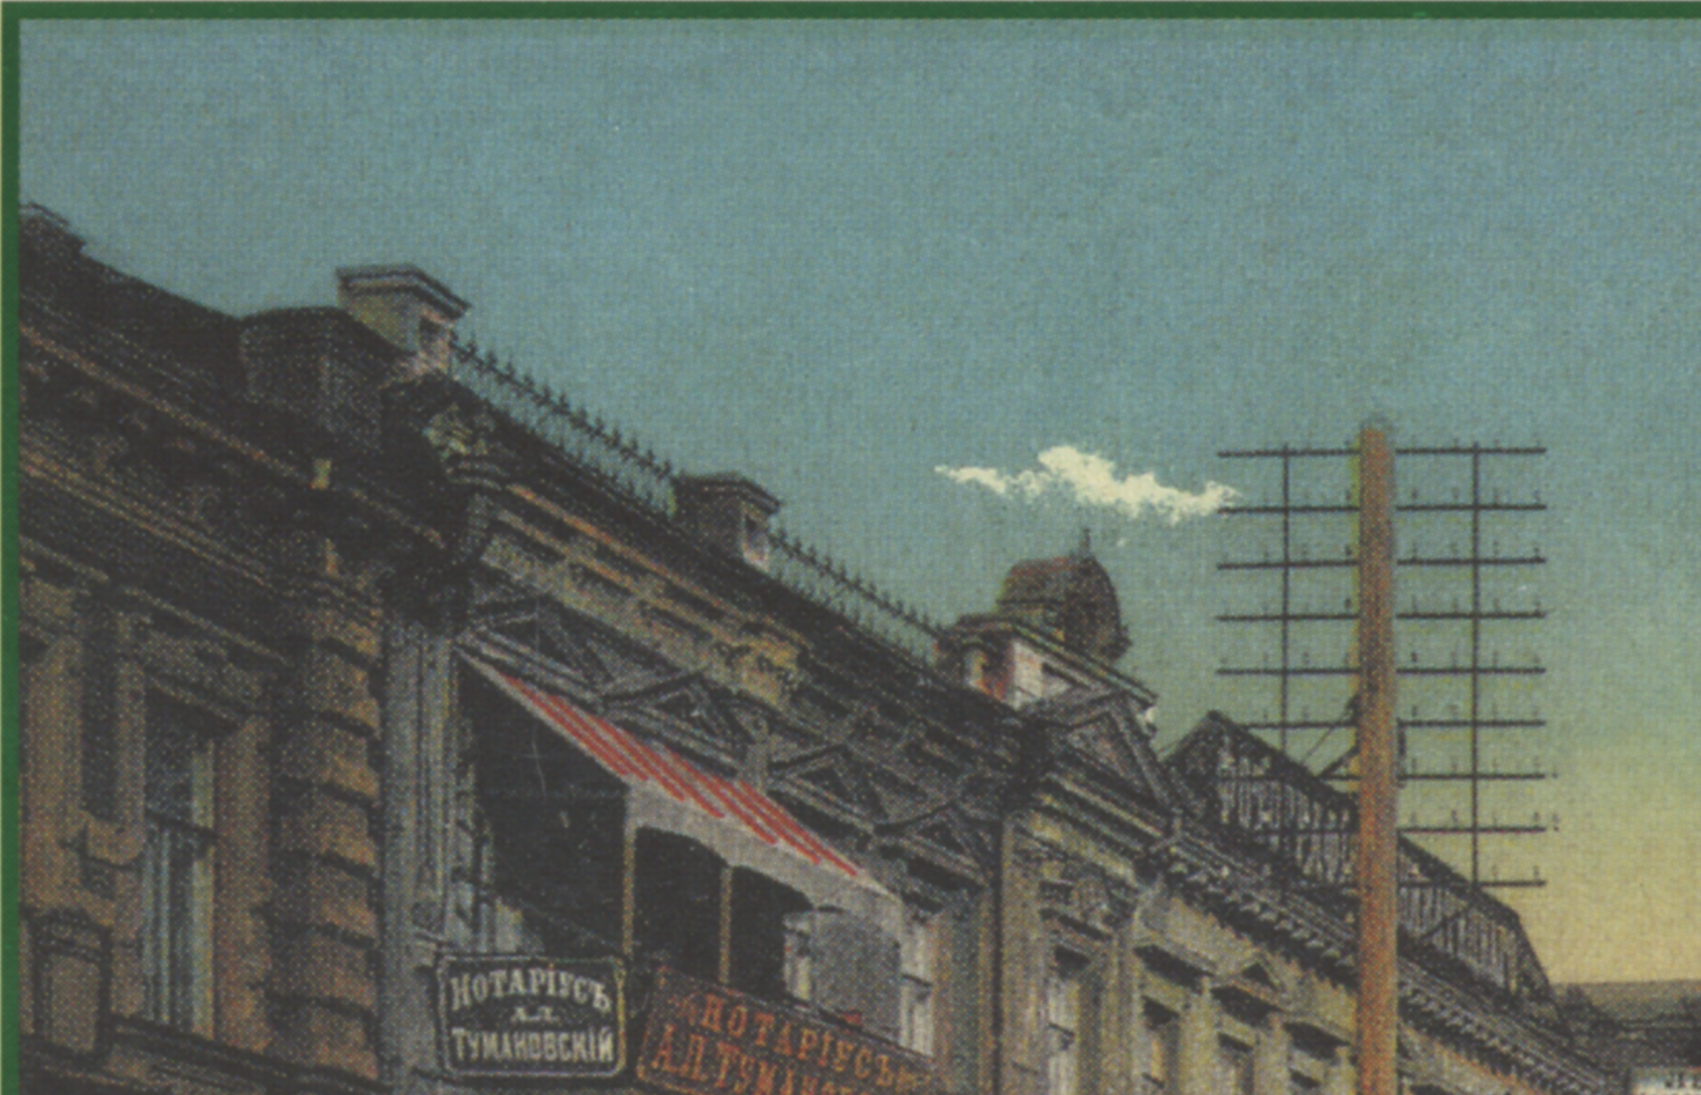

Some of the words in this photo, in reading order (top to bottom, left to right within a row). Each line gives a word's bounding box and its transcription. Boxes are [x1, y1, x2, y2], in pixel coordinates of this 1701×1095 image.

[449, 962, 611, 1013] НОТАРІУСЪ
[451, 1026, 614, 1062] ТУМАНОВСКІЙ
[699, 990, 894, 1089] НОТАРІУСЪ
